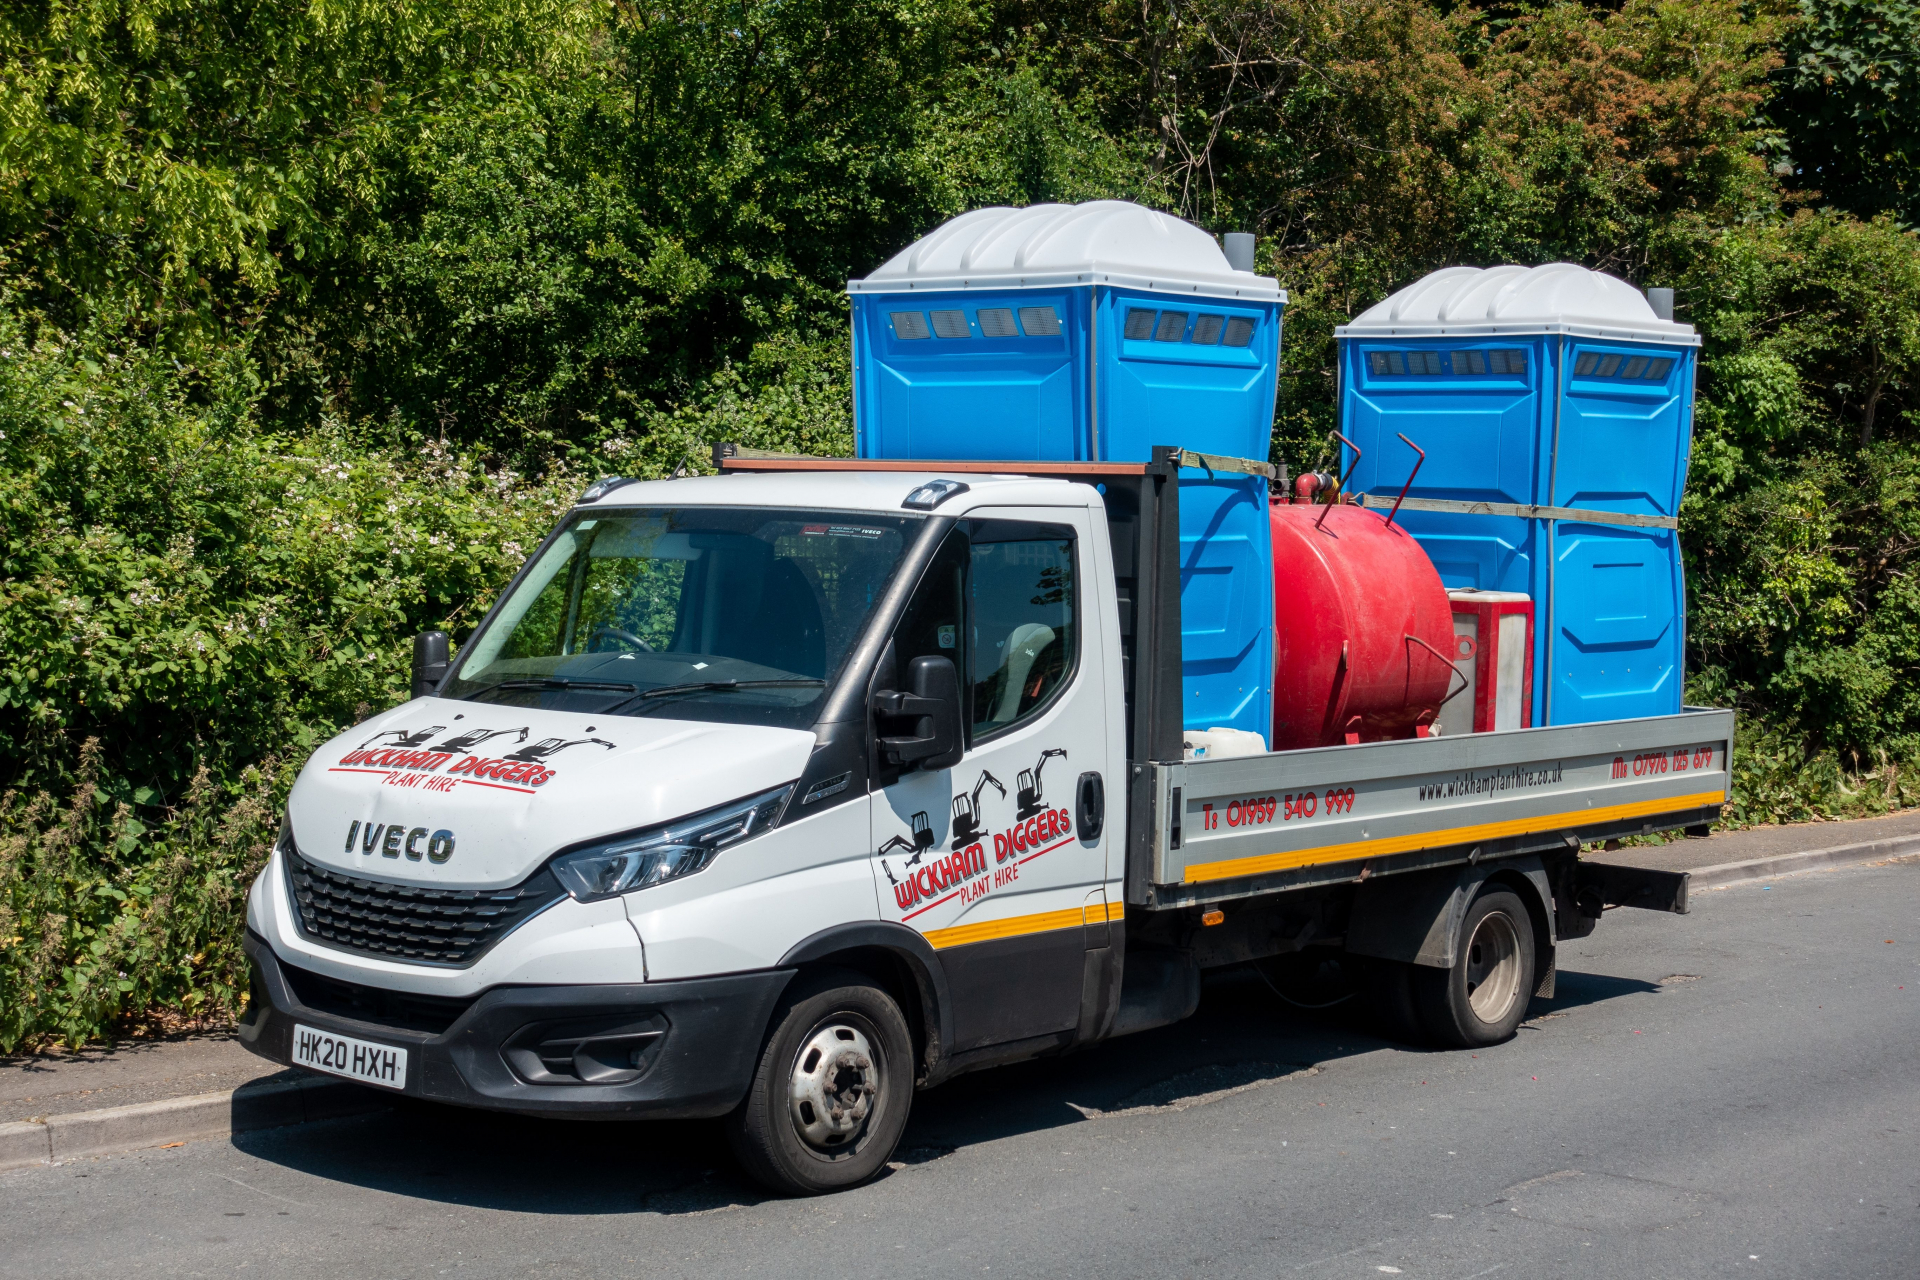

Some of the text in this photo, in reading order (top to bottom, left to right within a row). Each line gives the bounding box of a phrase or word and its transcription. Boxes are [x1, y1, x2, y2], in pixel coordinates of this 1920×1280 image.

[338, 748, 557, 787] WICKHAM DIGGERS
[382, 771, 462, 792] PLANT HIRE
[1419, 761, 1563, 801] www.wickhamplanthire.co.uk
[1612, 746, 1713, 779] M: 07976 125 679
[1202, 787, 1355, 831] T: 01959 540 999
[344, 819, 456, 865] IVECO
[893, 807, 1071, 910] WICKHAM DIGGERS
[959, 862, 1019, 906] PLANT HIRE
[299, 1030, 397, 1082] HK20 HXH
